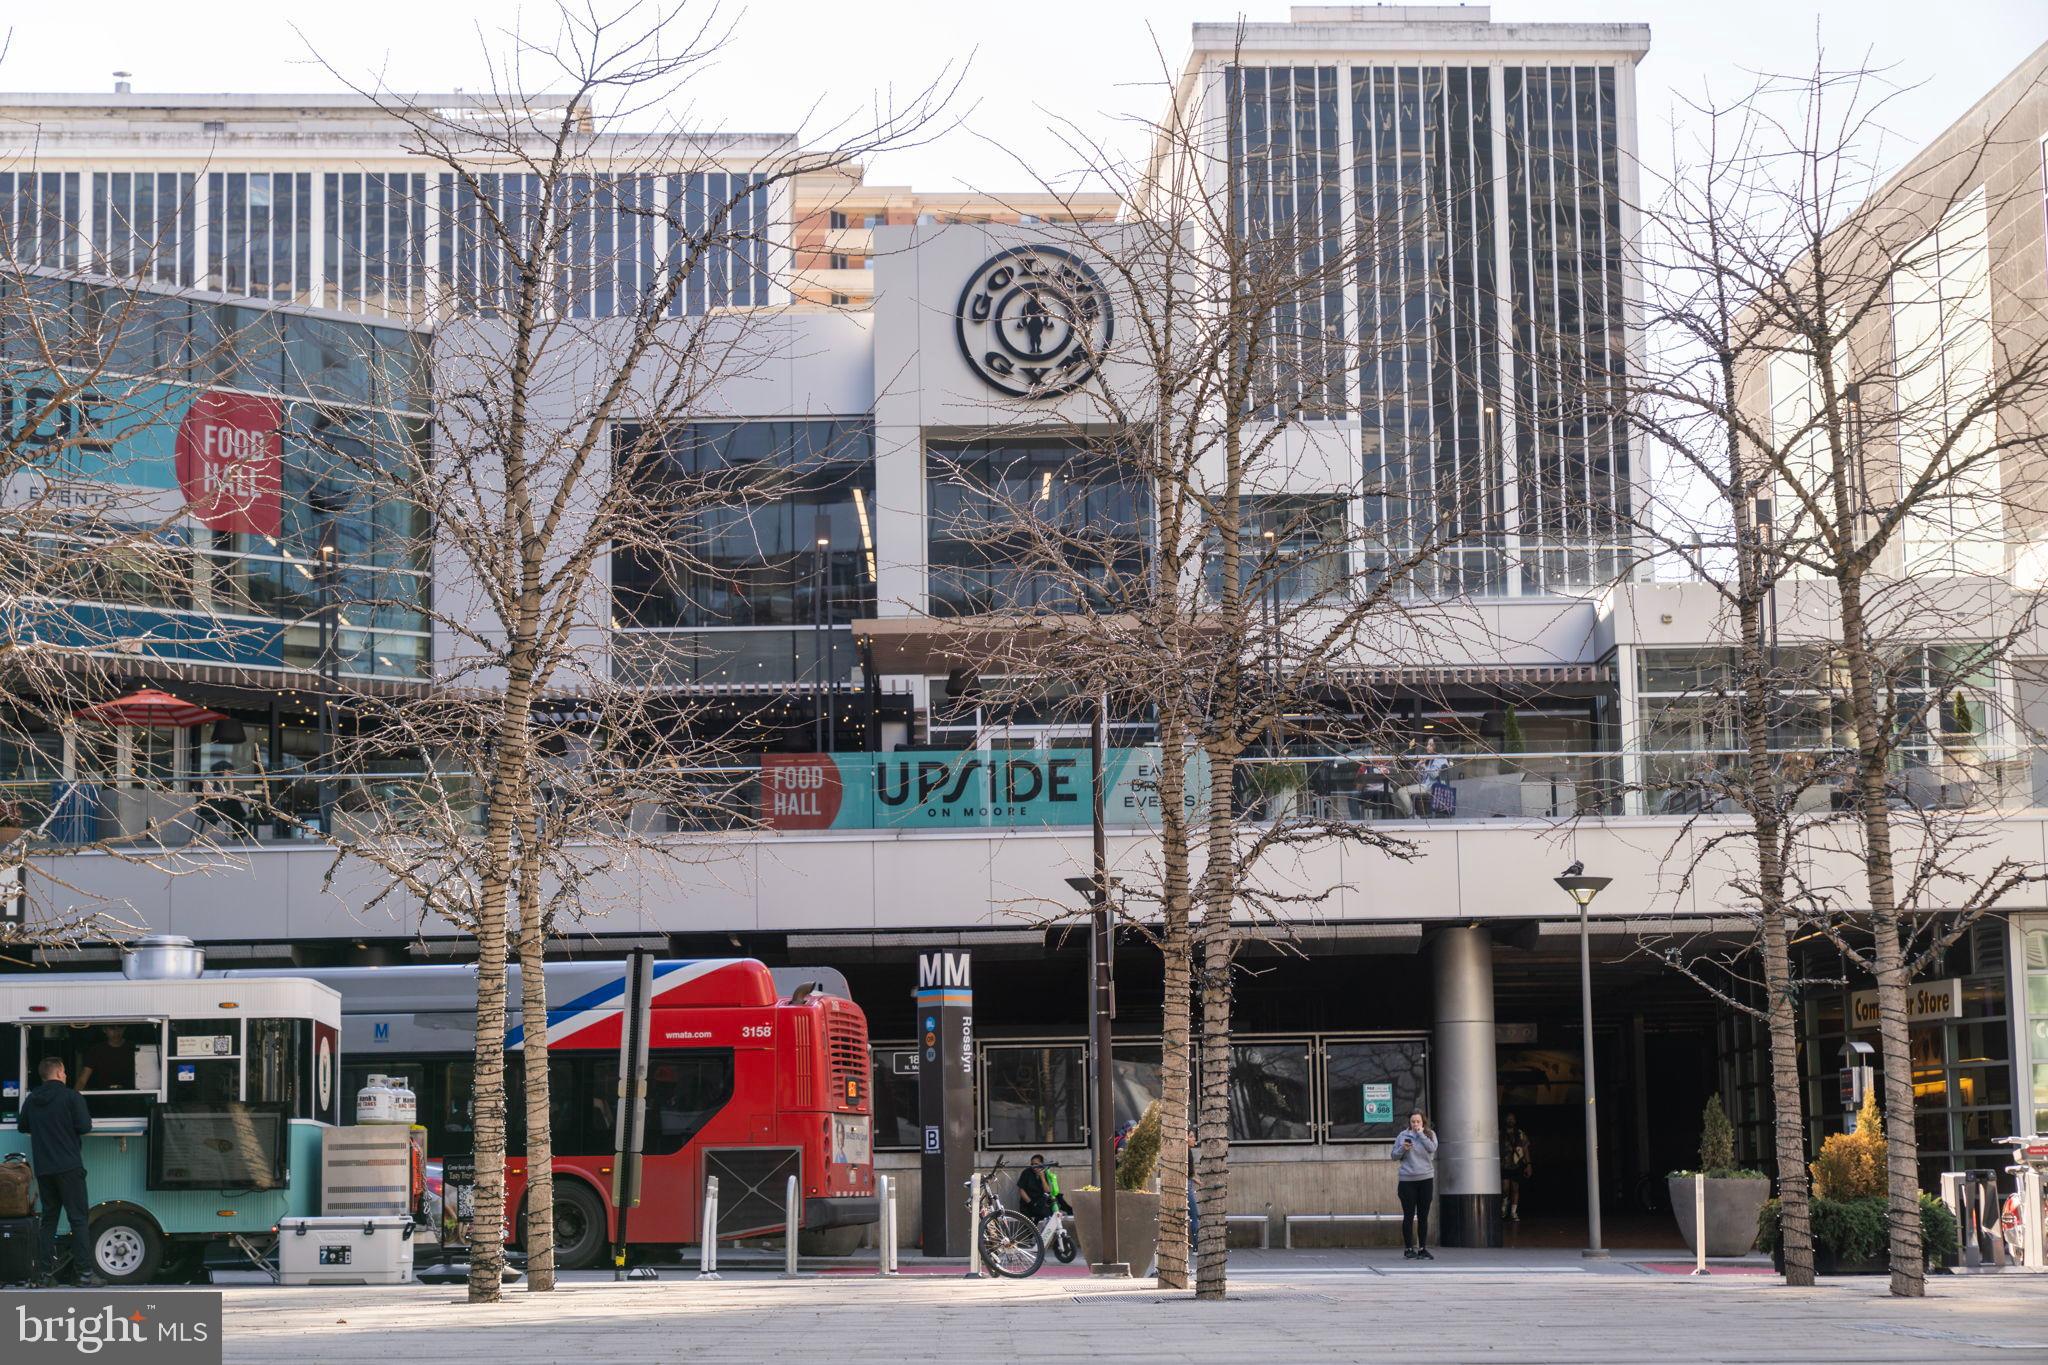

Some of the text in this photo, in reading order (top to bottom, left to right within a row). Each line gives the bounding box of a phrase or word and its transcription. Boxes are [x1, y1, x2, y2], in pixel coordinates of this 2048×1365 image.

[984, 344, 1091, 386] GYM
[204, 424, 264, 461] FOOD
[204, 462, 262, 498] HALL
[774, 766, 823, 789] FOOD
[877, 758, 1078, 806] UPSIDE
[774, 792, 822, 816] HALL
[927, 808, 950, 818] ON
[963, 806, 1027, 817] MOORE
[1124, 795, 1196, 808] EVES
[920, 953, 942, 987] M
[944, 952, 970, 987] M
[1917, 990, 1950, 1015] Store
[375, 1023, 389, 1040] M
[665, 1031, 713, 1039] wmata.com
[742, 1026, 772, 1038] 3158
[961, 1016, 972, 1073] Rosslyn
[927, 1130, 938, 1148] B
